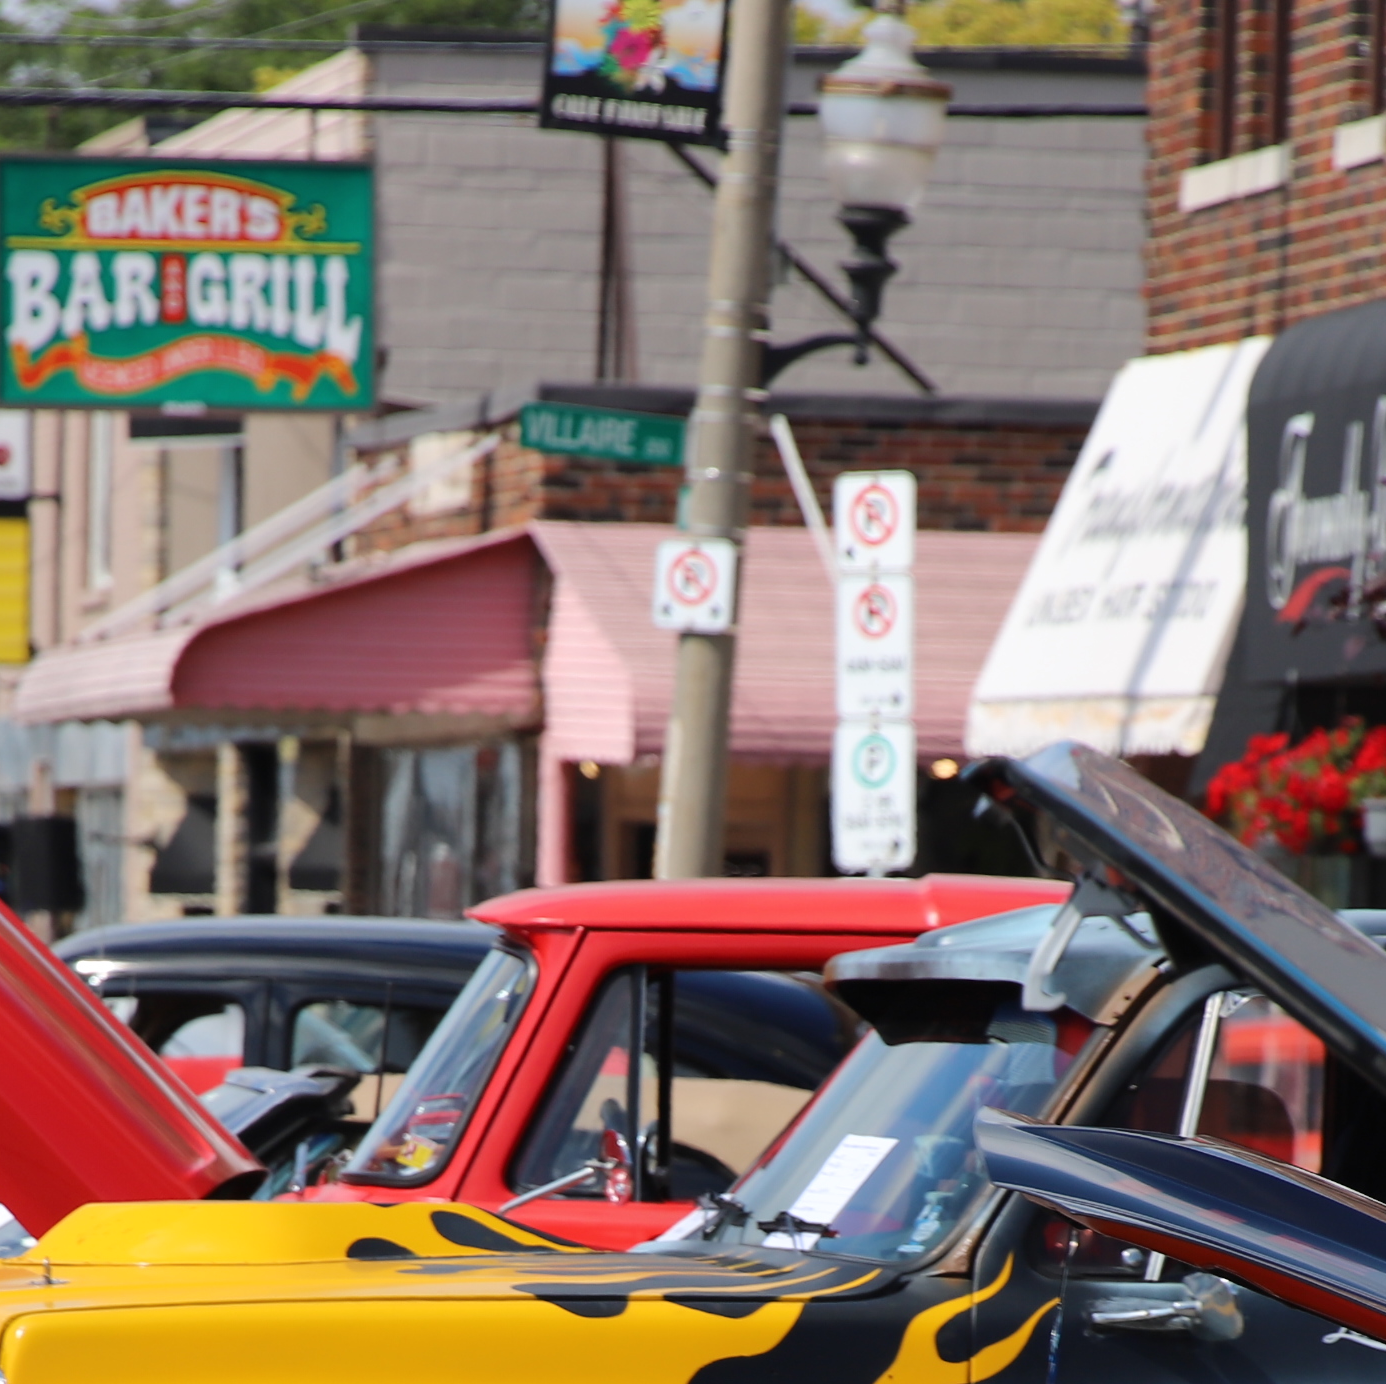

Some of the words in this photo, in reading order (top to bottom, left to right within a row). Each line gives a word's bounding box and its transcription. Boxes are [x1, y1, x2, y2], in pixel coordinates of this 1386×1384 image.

[85, 184, 280, 241] BAKER'S
[4, 250, 161, 352] BAR
[188, 253, 363, 362] GRILL
